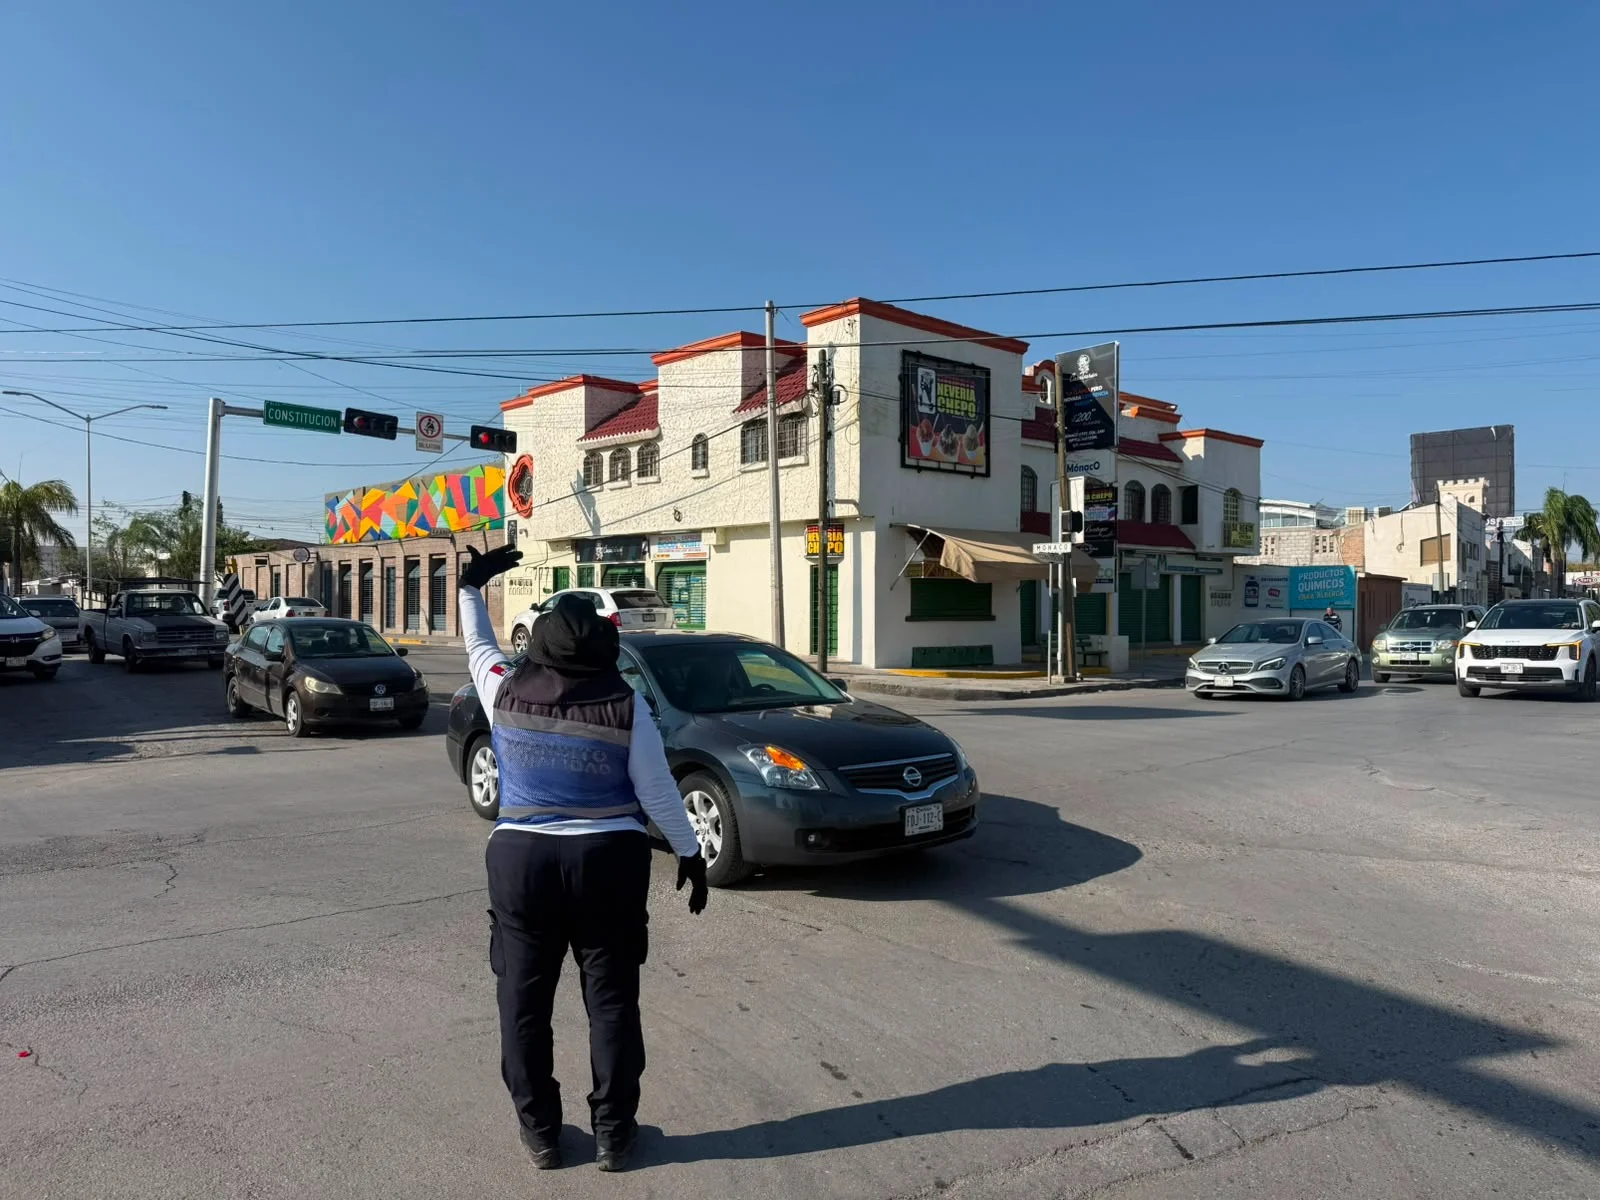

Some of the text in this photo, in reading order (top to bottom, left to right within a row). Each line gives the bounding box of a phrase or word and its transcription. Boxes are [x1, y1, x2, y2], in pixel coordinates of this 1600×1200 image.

[937, 383, 976, 402] NEVERIA
[937, 397, 976, 418] CHEPO
[268, 408, 337, 428] CONSTITUCION
[808, 542, 843, 553] CHPO
[1036, 543, 1068, 551] MONACO
[1298, 568, 1344, 580] PRODUCTOS
[1298, 578, 1344, 592] QUIMICOS
